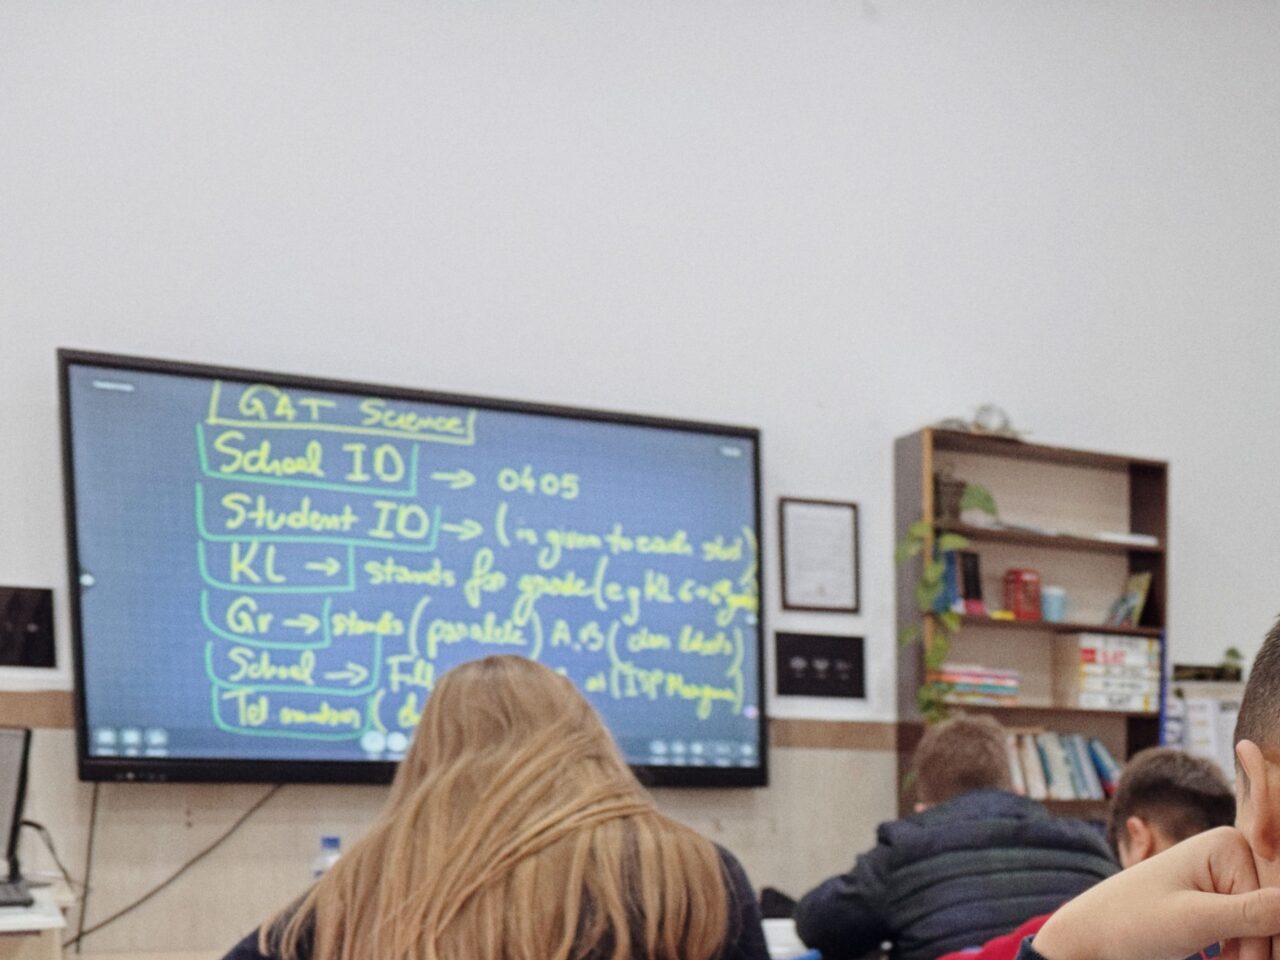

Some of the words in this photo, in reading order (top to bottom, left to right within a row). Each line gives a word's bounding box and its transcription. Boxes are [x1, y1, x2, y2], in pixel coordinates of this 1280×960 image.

[214, 430, 325, 478] School
[342, 442, 405, 483] ID
[497, 464, 581, 500] 0405
[221, 491, 360, 531] Student
[368, 498, 430, 540] ID
[230, 541, 287, 584] KL
[228, 647, 316, 686] School
